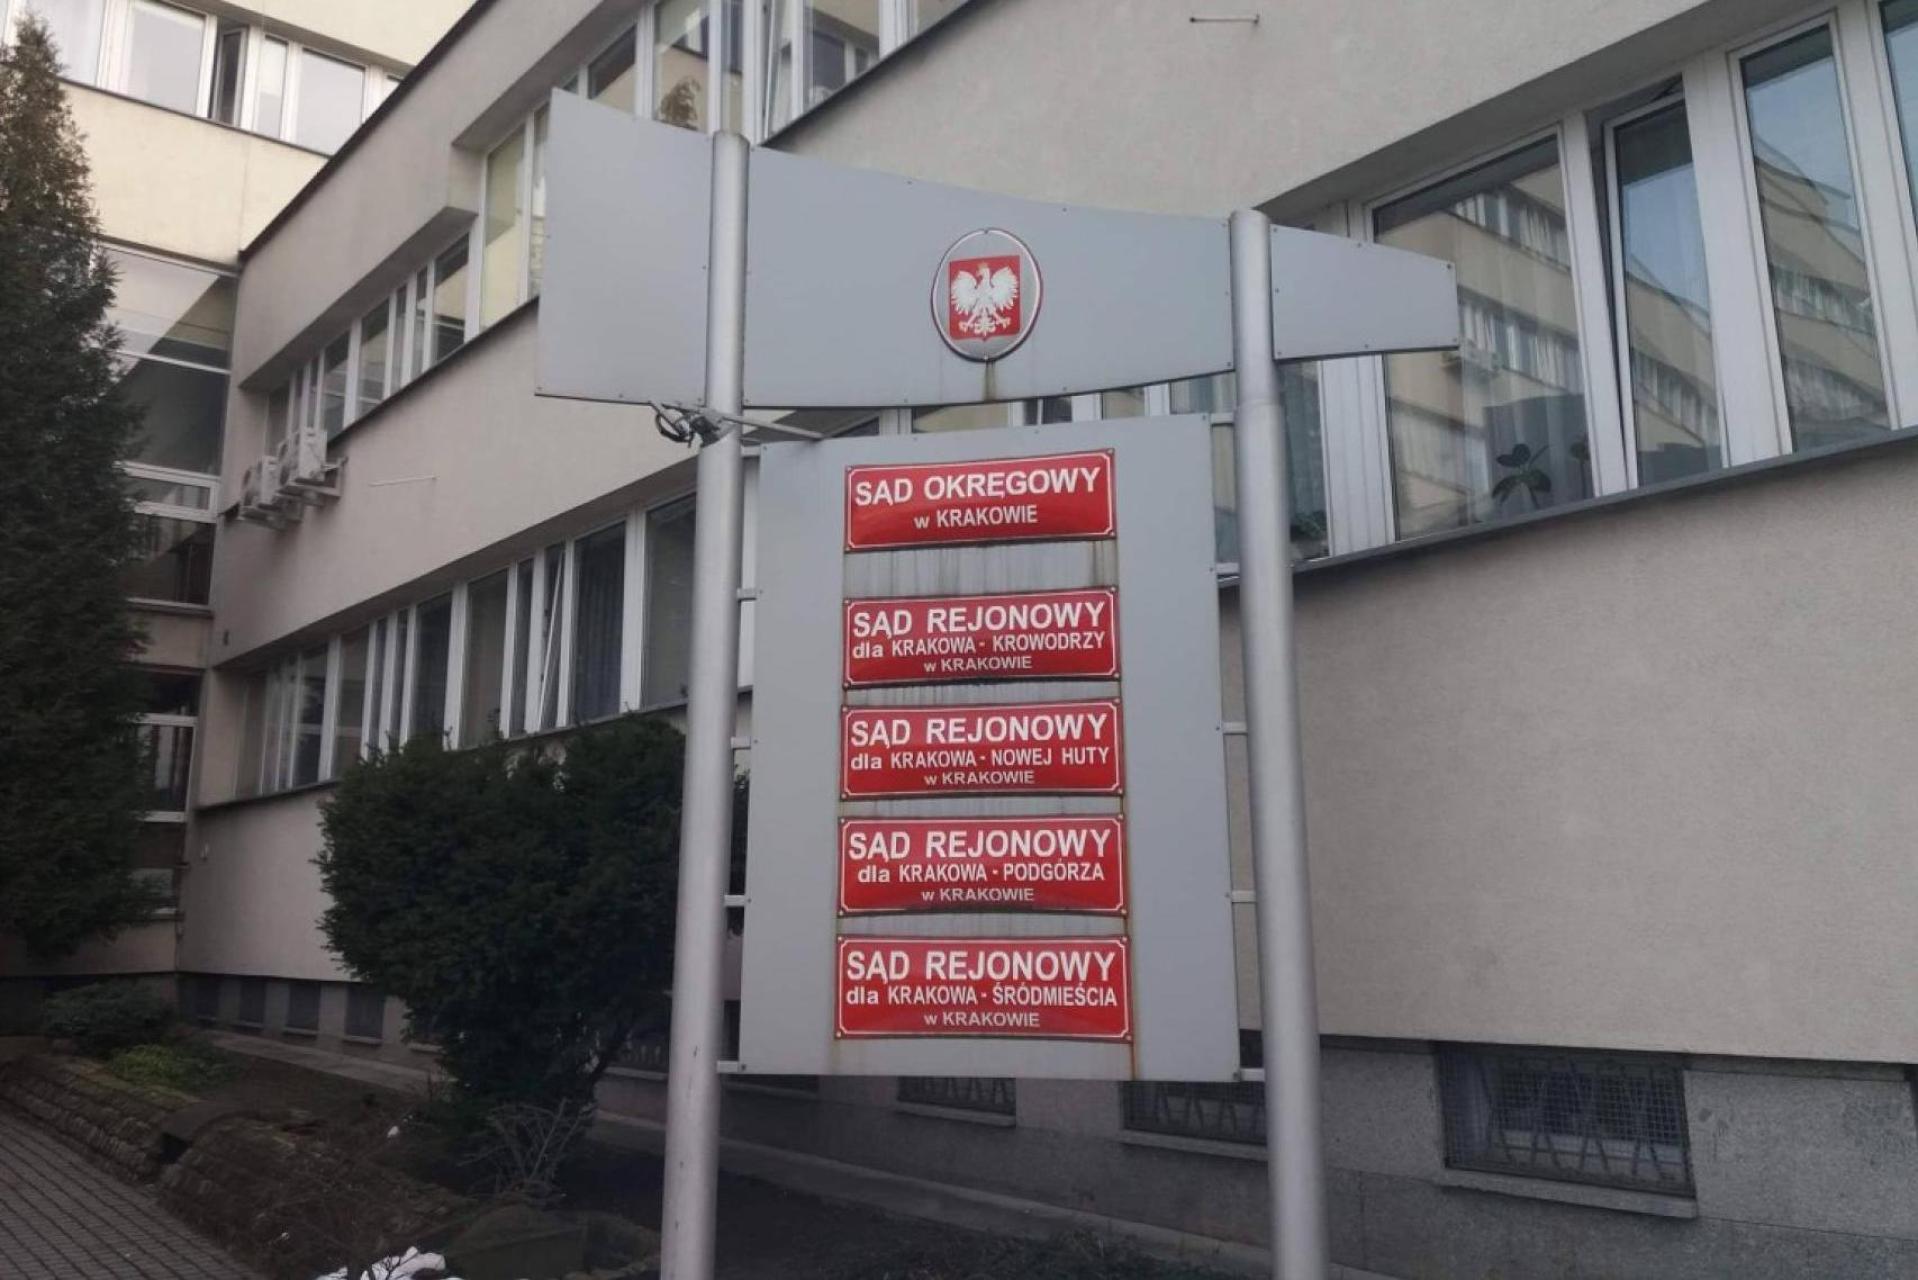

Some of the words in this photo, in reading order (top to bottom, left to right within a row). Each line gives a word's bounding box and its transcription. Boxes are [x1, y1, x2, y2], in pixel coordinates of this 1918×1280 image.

[855, 478, 913, 506] SĄD
[924, 467, 1100, 500] OKRĘGOWY
[914, 517, 929, 529] w
[937, 505, 1038, 527] KRAKOWIE
[853, 609, 912, 639] SĄD
[927, 601, 1105, 633] REJONOWY
[853, 643, 883, 659] dla
[892, 638, 976, 657] KRAKOWA
[992, 632, 1105, 652] KROWODRZY
[924, 662, 936, 672] w
[941, 656, 1032, 672] KRAKOWIE
[851, 719, 911, 749] SĄD
[926, 714, 1107, 744] REJONOWY
[851, 754, 882, 770] dla
[891, 750, 976, 769] KRAKOWA
[992, 748, 1052, 766] NOWEJ
[1062, 747, 1109, 765] HUTY
[924, 775, 937, 785] w
[942, 770, 1035, 785] KRAKOWIE
[849, 832, 910, 862] SĄD
[926, 829, 1111, 858] REJONOWY
[858, 867, 890, 883] dla
[899, 864, 987, 882] KRAKOWA
[1004, 859, 1105, 881] PODGÓRZA
[921, 890, 934, 901] w
[940, 888, 1034, 901] KRAKOWIE
[847, 952, 909, 983] SĄD
[926, 951, 1115, 981] REJONOWY
[847, 987, 878, 1005] dla
[888, 986, 978, 1005] KRAKOWA
[992, 982, 1117, 1006] ŚRÓDMIEŚCIA
[924, 1014, 937, 1026] w
[943, 1012, 1040, 1027] KRAKOWIE
